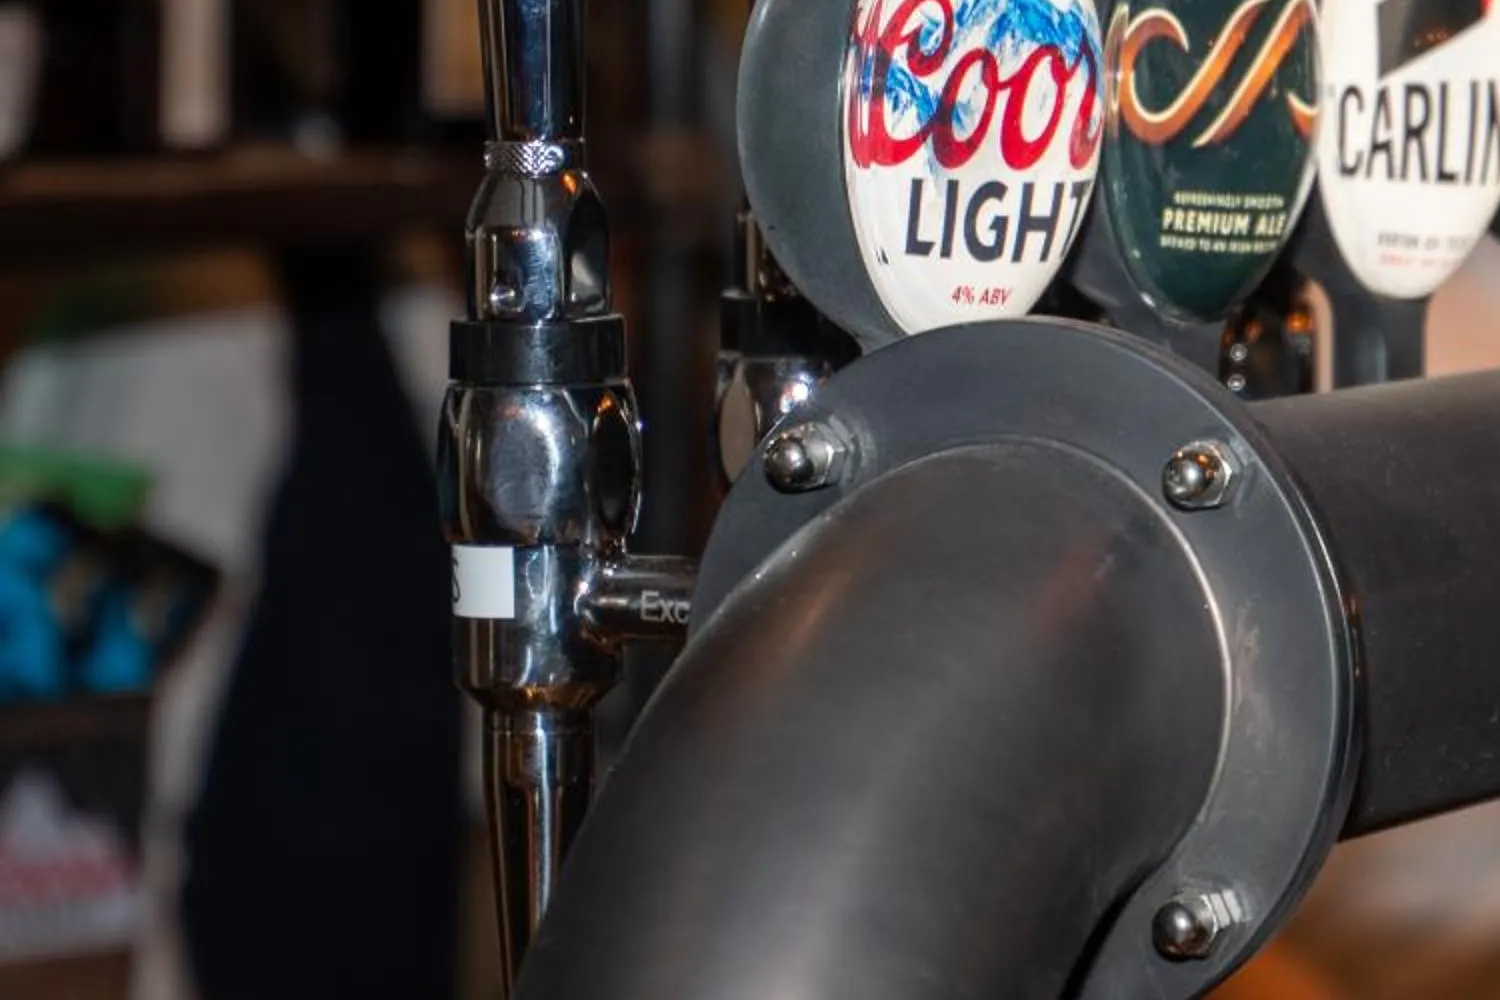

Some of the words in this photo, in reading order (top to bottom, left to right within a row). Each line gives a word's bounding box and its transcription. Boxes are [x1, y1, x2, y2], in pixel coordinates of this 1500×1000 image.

[905, 177, 1092, 264] LIGHT
[1162, 207, 1249, 236] PREMIUM
[1254, 211, 1285, 236] ALE
[951, 285, 975, 305] 4%
[979, 287, 1012, 306] ABV
[640, 590, 690, 625] Exc
